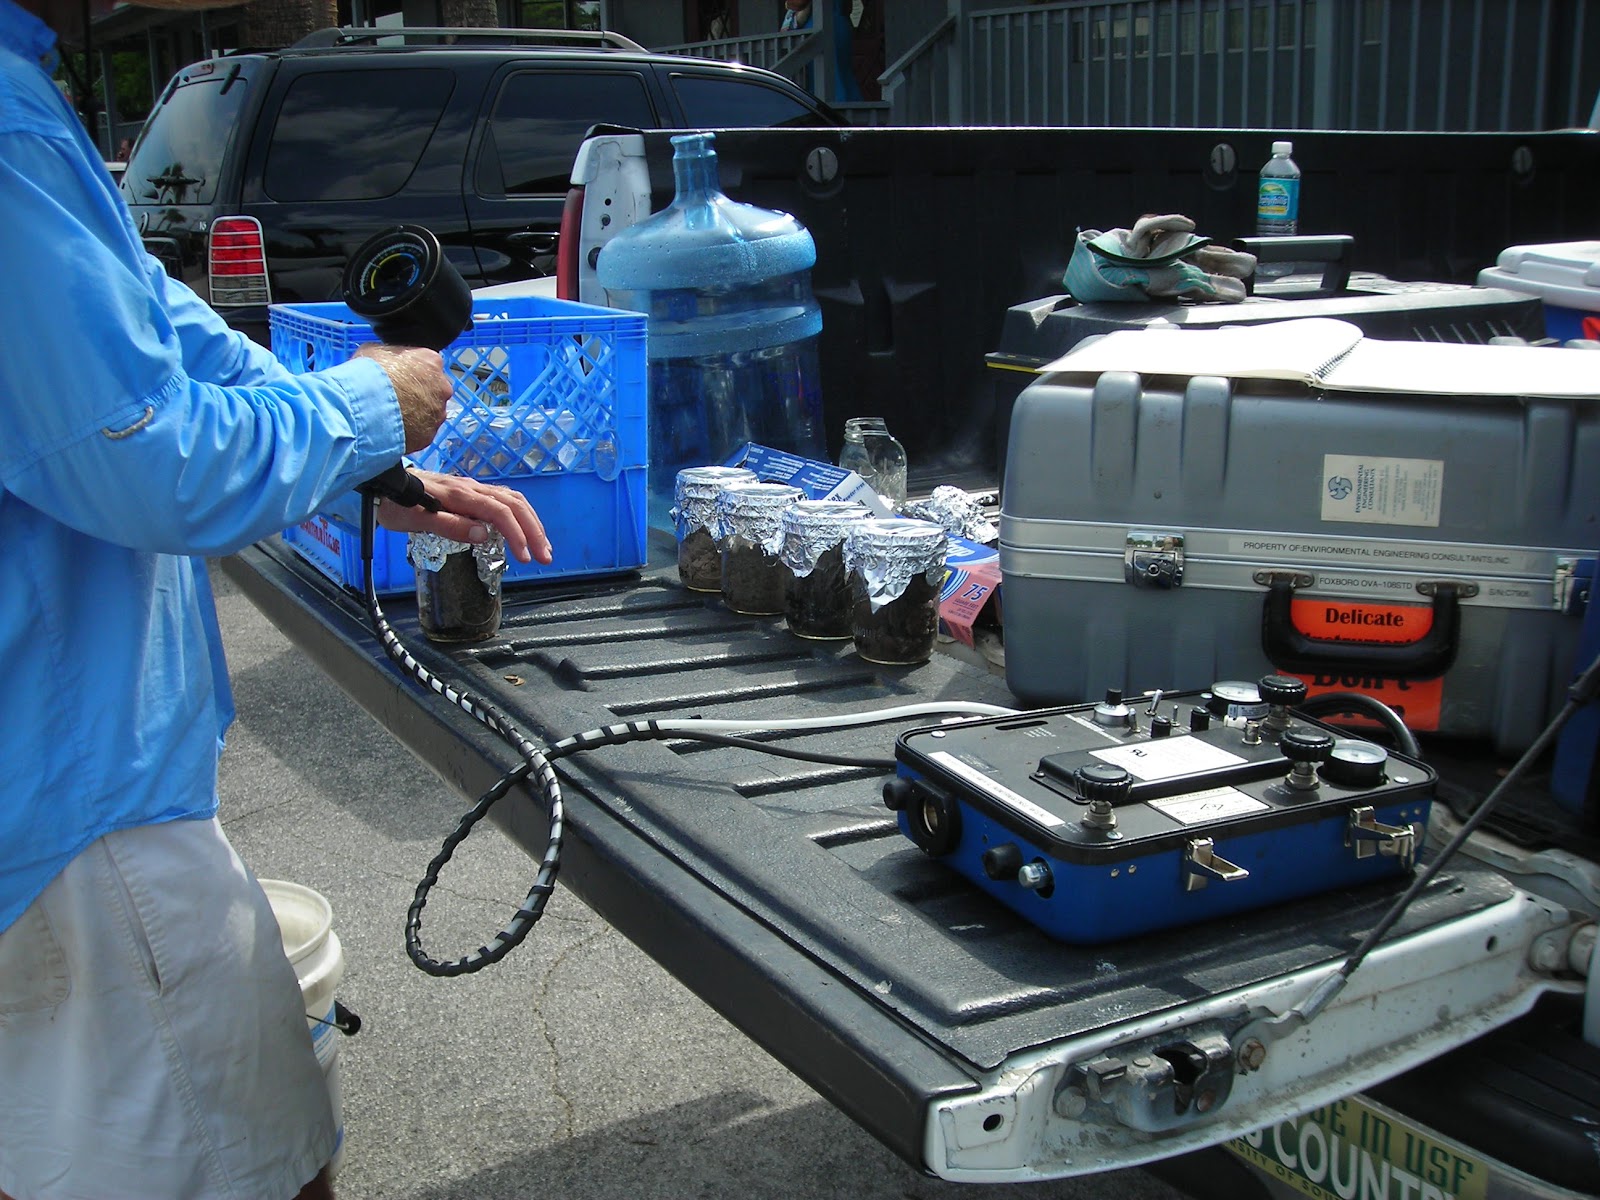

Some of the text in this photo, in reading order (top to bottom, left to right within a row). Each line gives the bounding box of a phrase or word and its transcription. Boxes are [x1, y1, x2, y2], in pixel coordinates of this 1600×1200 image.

[1355, 464, 1364, 513] ENVIRONMENTAL
[1362, 469, 1370, 509] ENGINEERING
[1368, 468, 1376, 510] CONSULTANTS
[1243, 541, 1287, 552] PROPERTY
[1373, 549, 1430, 560] ENGINEERING
[961, 583, 988, 602] 75
[1319, 577, 1413, 590] FOXBORO OVA-108STD
[1325, 607, 1405, 627] Delicate
[1276, 1165, 1295, 1180] OF
[1404, 1131, 1474, 1195] USF
